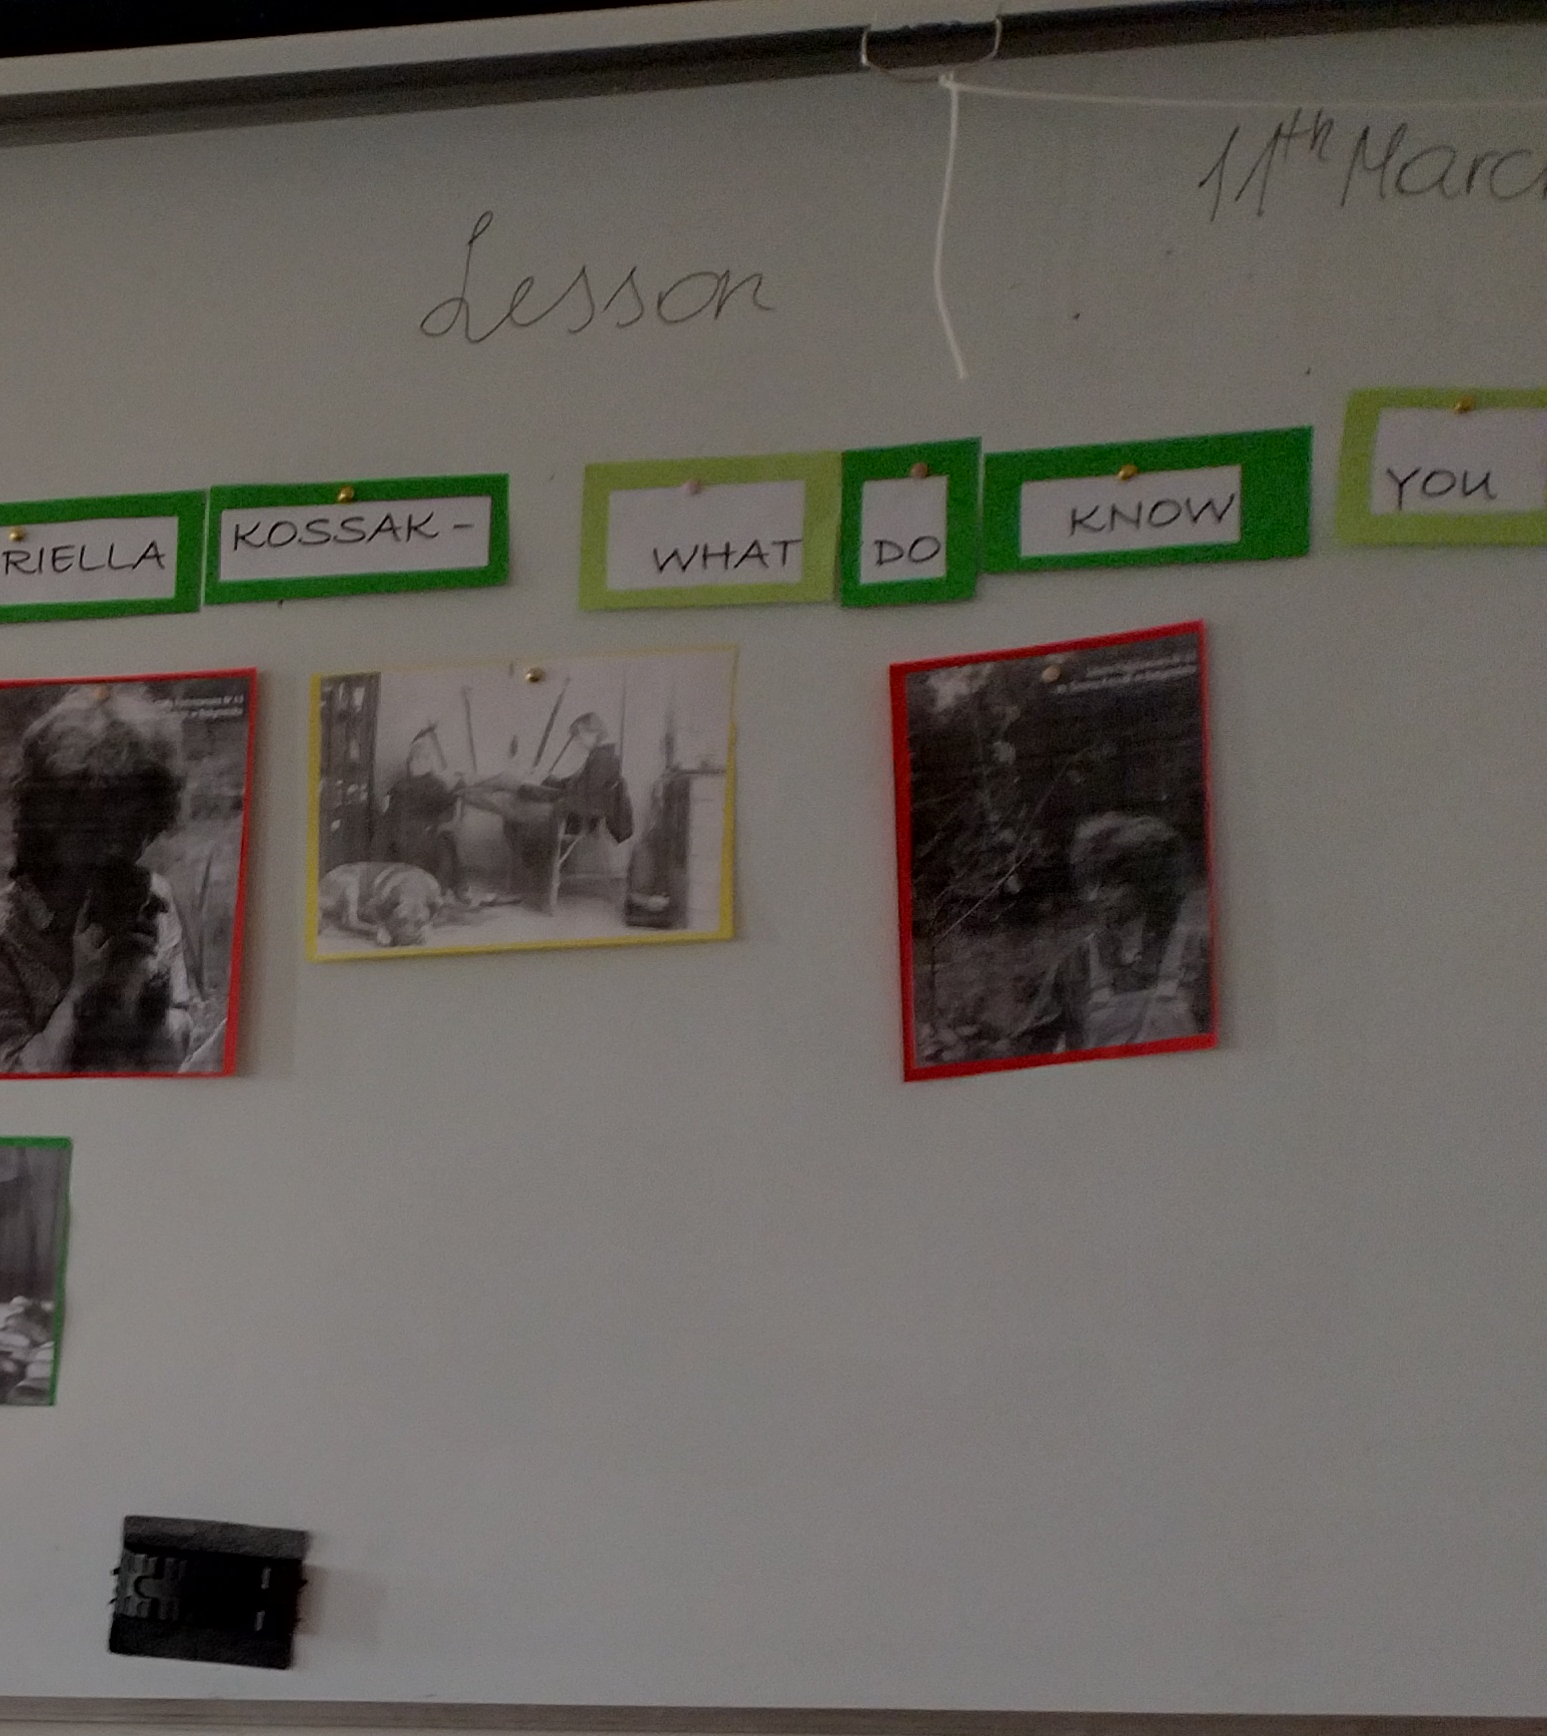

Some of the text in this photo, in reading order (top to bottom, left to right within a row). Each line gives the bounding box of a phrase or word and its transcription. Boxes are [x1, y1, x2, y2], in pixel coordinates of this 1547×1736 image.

[1340, 121, 1547, 208] Marc
[419, 210, 775, 344] Lesson
[651, 539, 804, 576] WHAT
[873, 535, 942, 568] DO
[1069, 493, 1237, 538] KNOW
[1386, 465, 1499, 510] YOU
